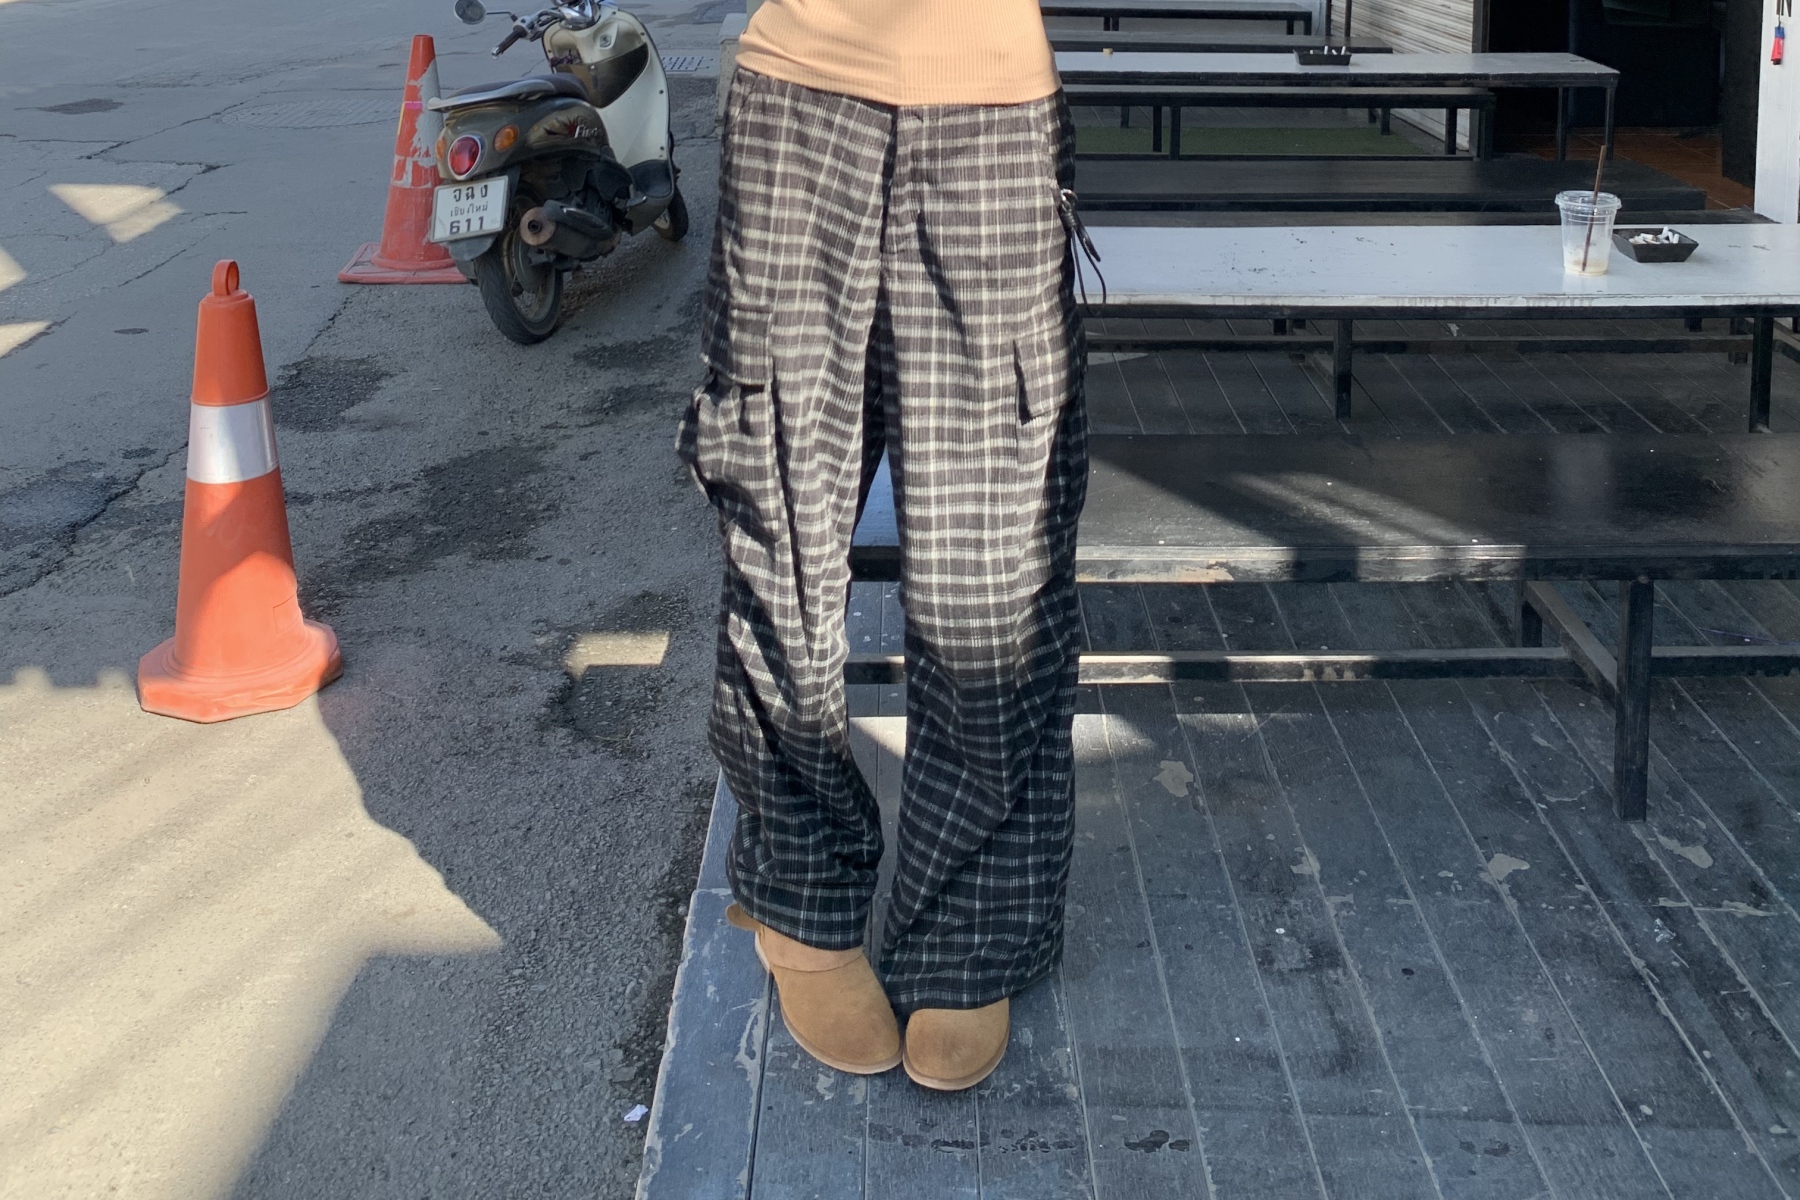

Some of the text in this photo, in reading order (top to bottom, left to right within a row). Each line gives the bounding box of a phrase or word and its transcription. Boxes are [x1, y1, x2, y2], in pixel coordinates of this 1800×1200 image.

[450, 201, 489, 217] เชียงใหม่
[449, 216, 485, 235] 611
